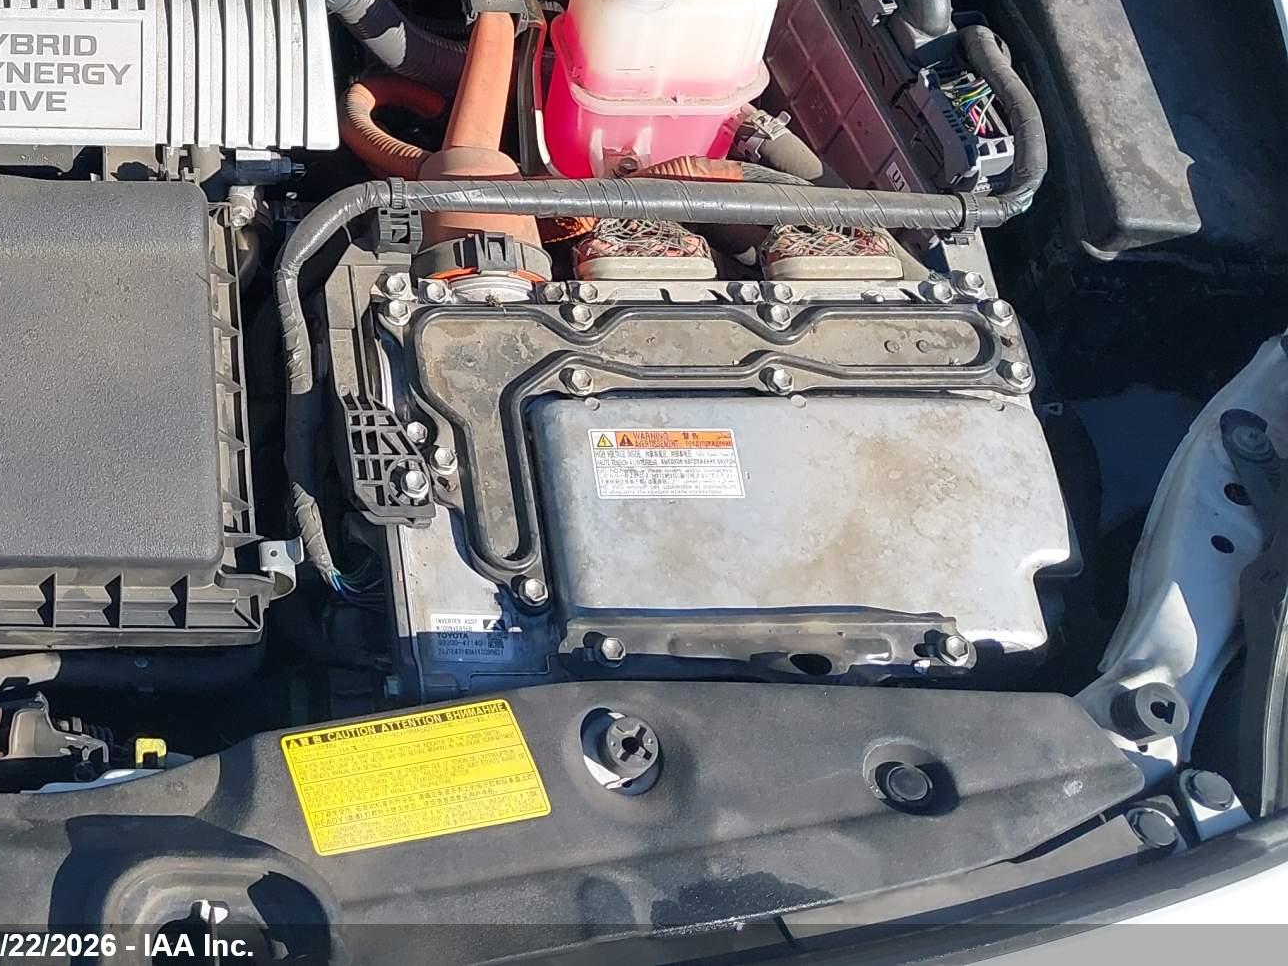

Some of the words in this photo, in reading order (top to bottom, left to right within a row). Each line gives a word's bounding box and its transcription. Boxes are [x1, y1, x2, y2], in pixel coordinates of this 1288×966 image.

[633, 432, 669, 440] WARNING
[437, 632, 469, 640] TOYOTA
[327, 726, 376, 741] CAUTION
[381, 714, 442, 732] ATTENTION
[446, 702, 506, 720] ВНИМАНИЕ
